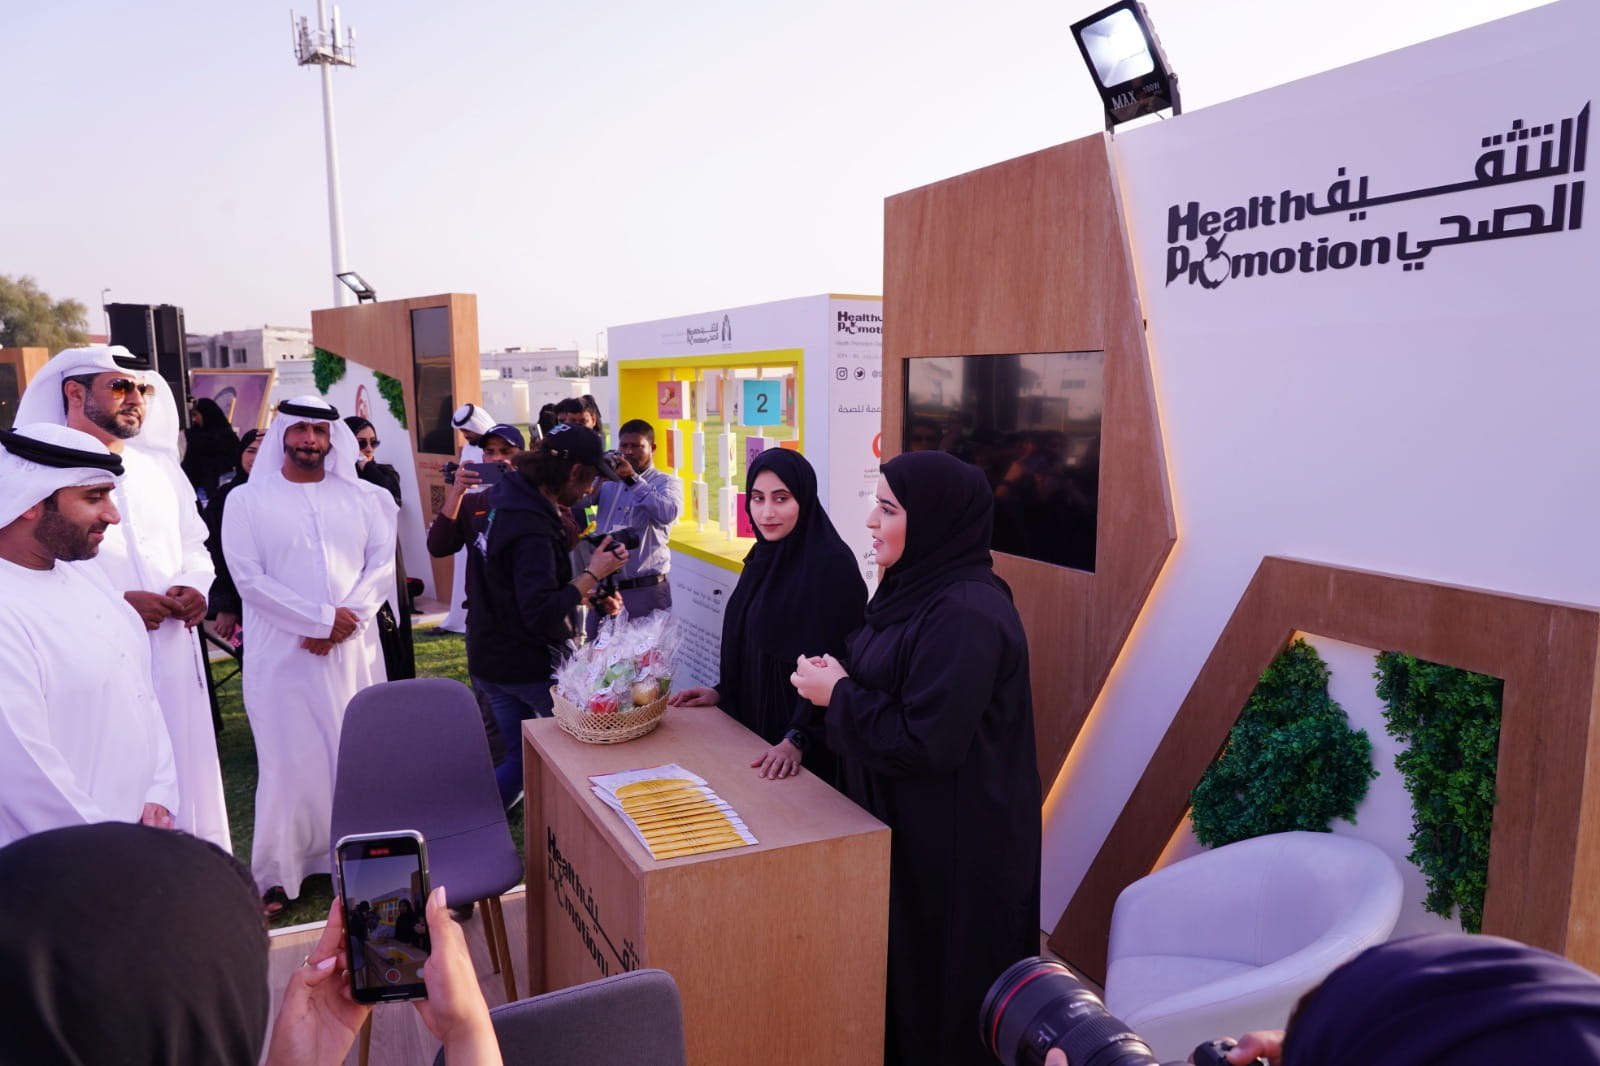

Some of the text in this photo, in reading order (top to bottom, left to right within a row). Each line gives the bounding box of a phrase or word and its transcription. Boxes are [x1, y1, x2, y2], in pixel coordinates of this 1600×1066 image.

[1111, 90, 1137, 110] MAX
[1305, 100, 1591, 222] التثقيف
[1167, 189, 1306, 243] Health
[1396, 181, 1585, 272] الصحي
[1166, 233, 1391, 289] Promotion
[837, 311, 878, 322] Health
[756, 393, 768, 413] 2
[547, 825, 585, 903] Health
[548, 856, 605, 976] Promotion
